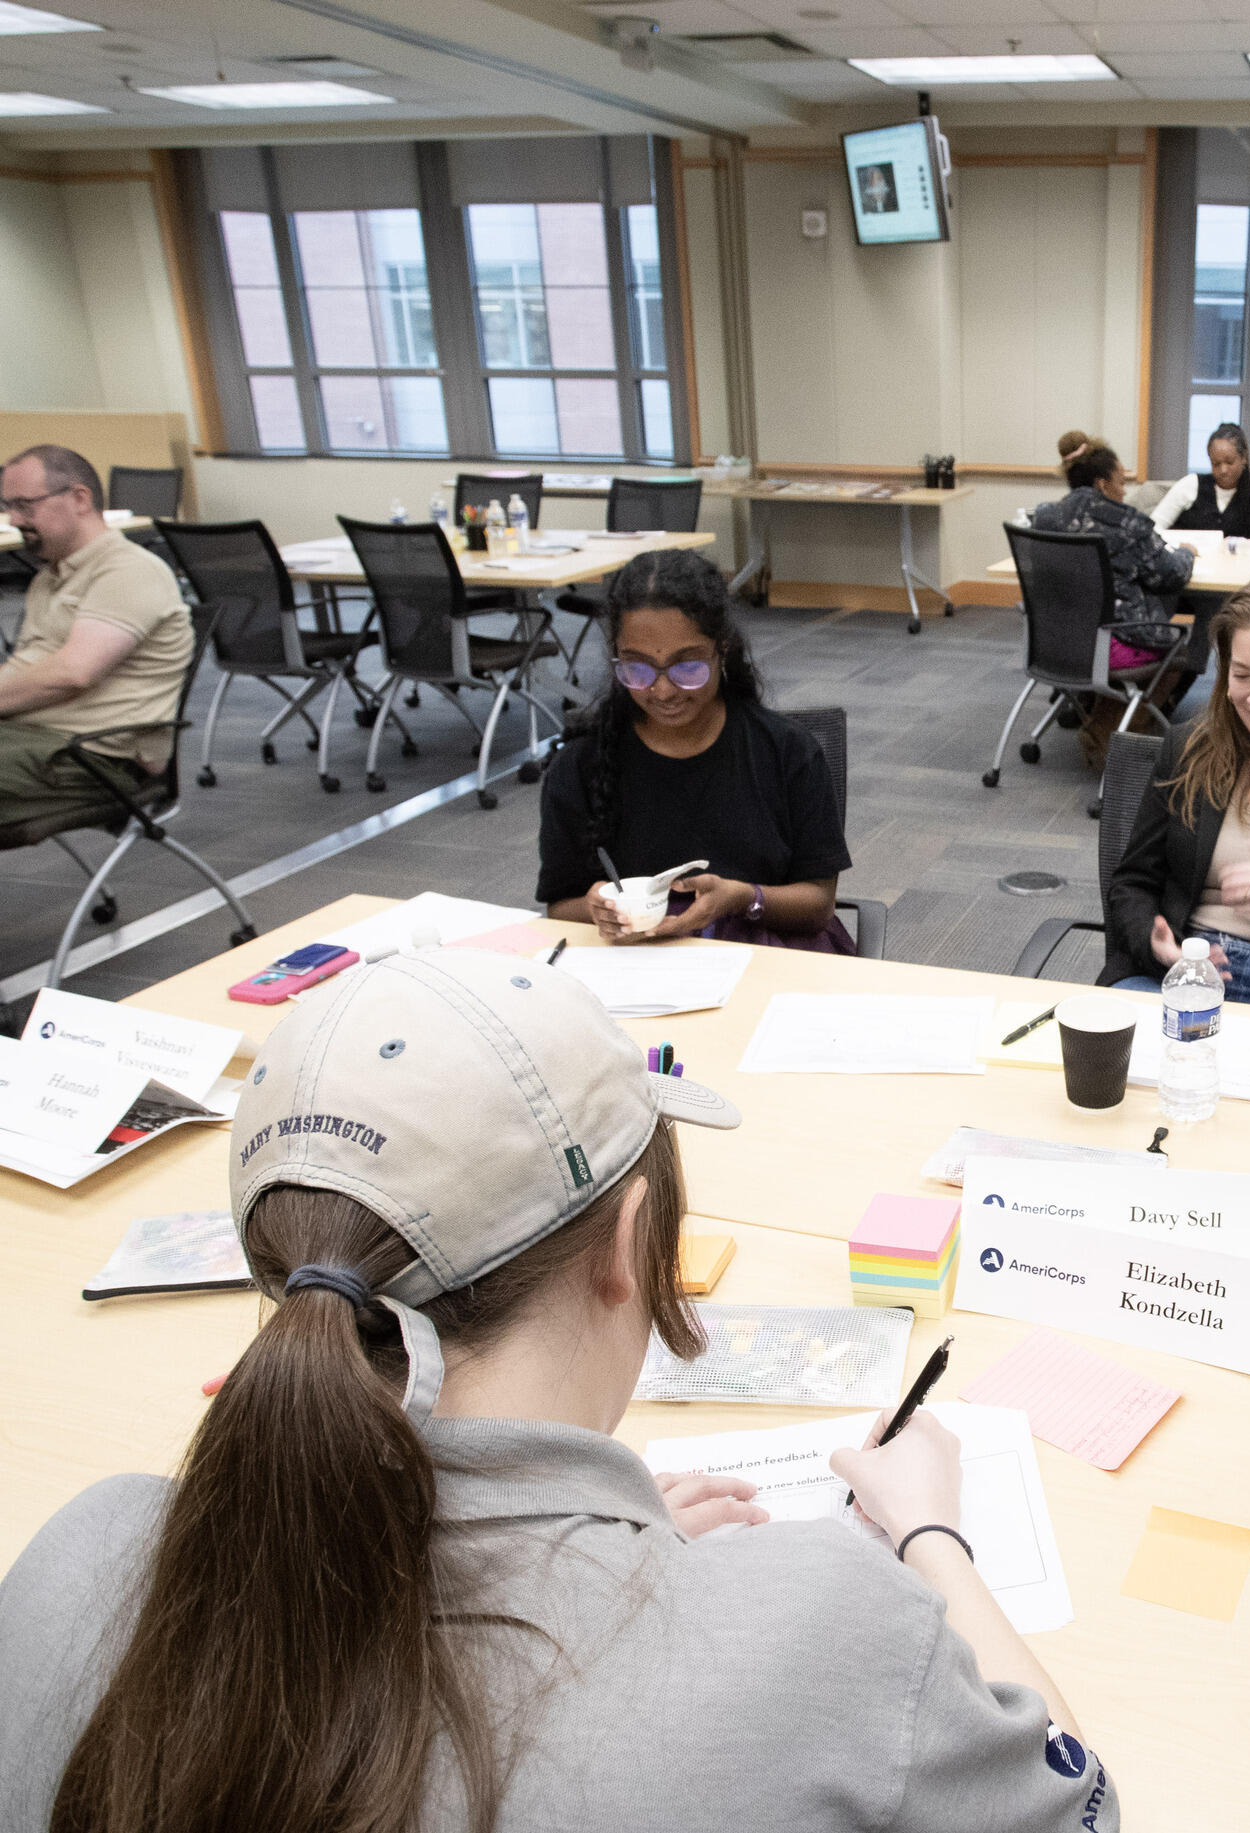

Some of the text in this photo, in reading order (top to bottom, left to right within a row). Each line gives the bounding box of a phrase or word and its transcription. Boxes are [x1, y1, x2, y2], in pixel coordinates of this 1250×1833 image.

[47, 1073, 101, 1098] Hannah
[35, 1096, 79, 1119] Moore
[240, 1114, 387, 1167] MARY WASHINGTON
[1011, 1202, 1085, 1219] AmeriCorps
[1129, 1205, 1222, 1230] Davy Sell
[1009, 1259, 1086, 1285] AmeriCorps
[1125, 1261, 1227, 1299] Elizabeth
[1119, 1290, 1224, 1330] Kondzella
[708, 1461, 743, 1473] based
[746, 1460, 761, 1468] on
[765, 1449, 823, 1466] feedback.
[774, 1481, 793, 1489] new
[796, 1474, 838, 1487] solution.
